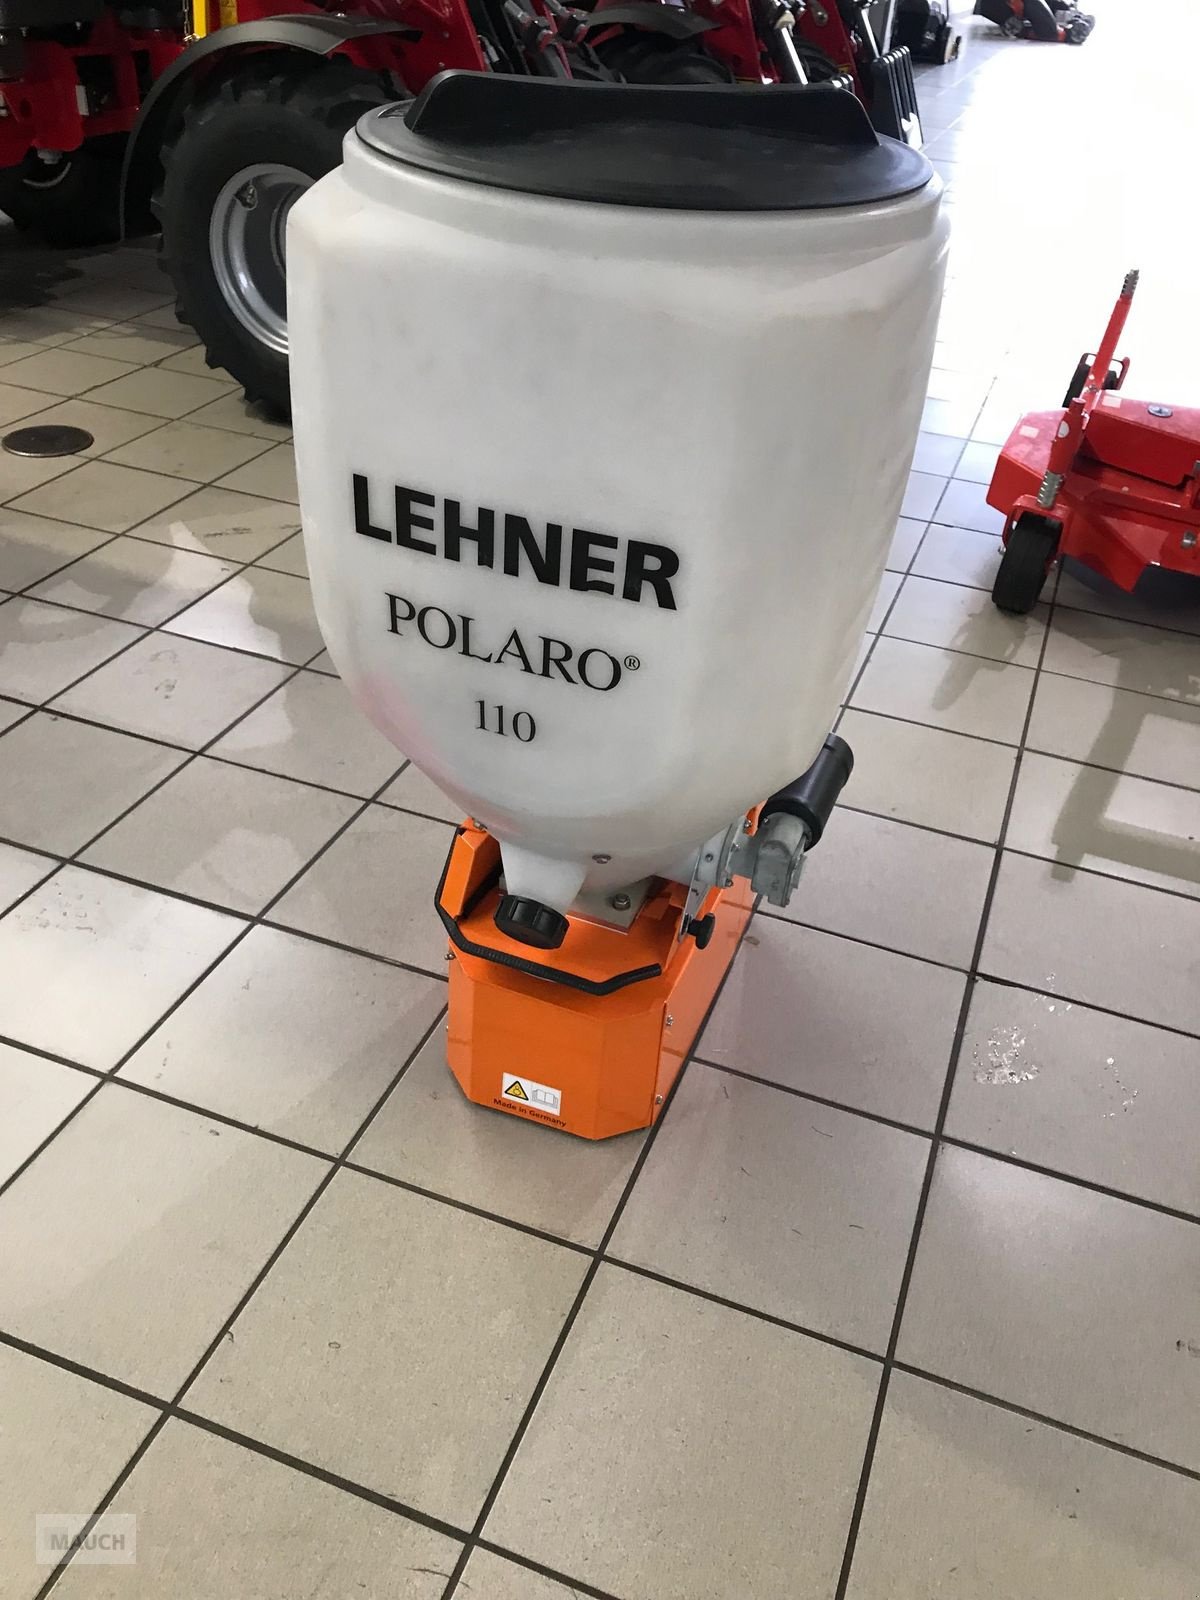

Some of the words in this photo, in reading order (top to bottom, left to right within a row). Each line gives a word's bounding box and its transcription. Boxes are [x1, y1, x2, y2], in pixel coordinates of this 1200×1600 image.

[353, 473, 680, 611] LEHNER
[475, 700, 536, 743] 110
[493, 1098, 517, 1111] Made
[519, 1106, 527, 1114] in
[529, 1109, 567, 1127] Germany
